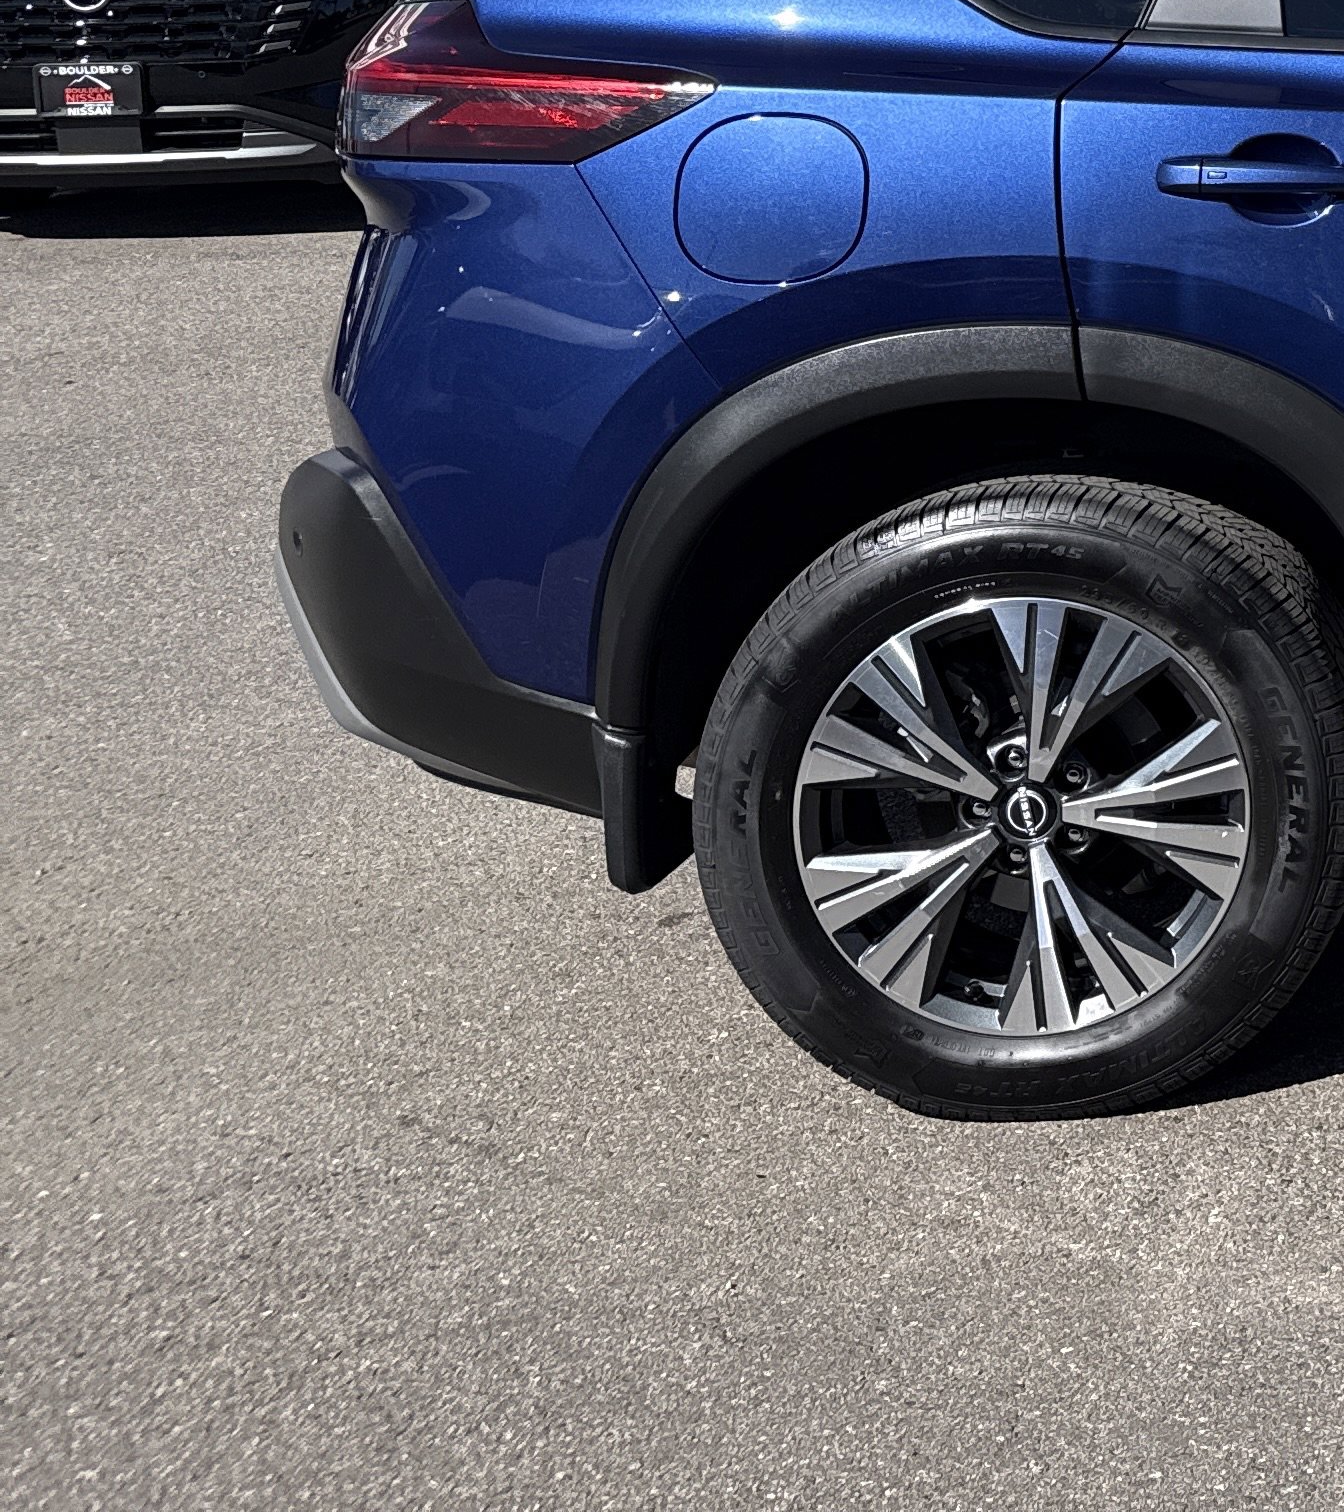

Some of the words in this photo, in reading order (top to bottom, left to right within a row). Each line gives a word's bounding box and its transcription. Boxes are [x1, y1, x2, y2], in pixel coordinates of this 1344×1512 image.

[59, 66, 115, 75] BOULDER
[65, 93, 113, 102] NISSAN
[67, 107, 112, 116] NISSAN
[998, 542, 1085, 561] RT45
[1257, 687, 1311, 893] GENERAL
[1017, 787, 1037, 836] NISSAN
[729, 750, 780, 955] GENERAL
